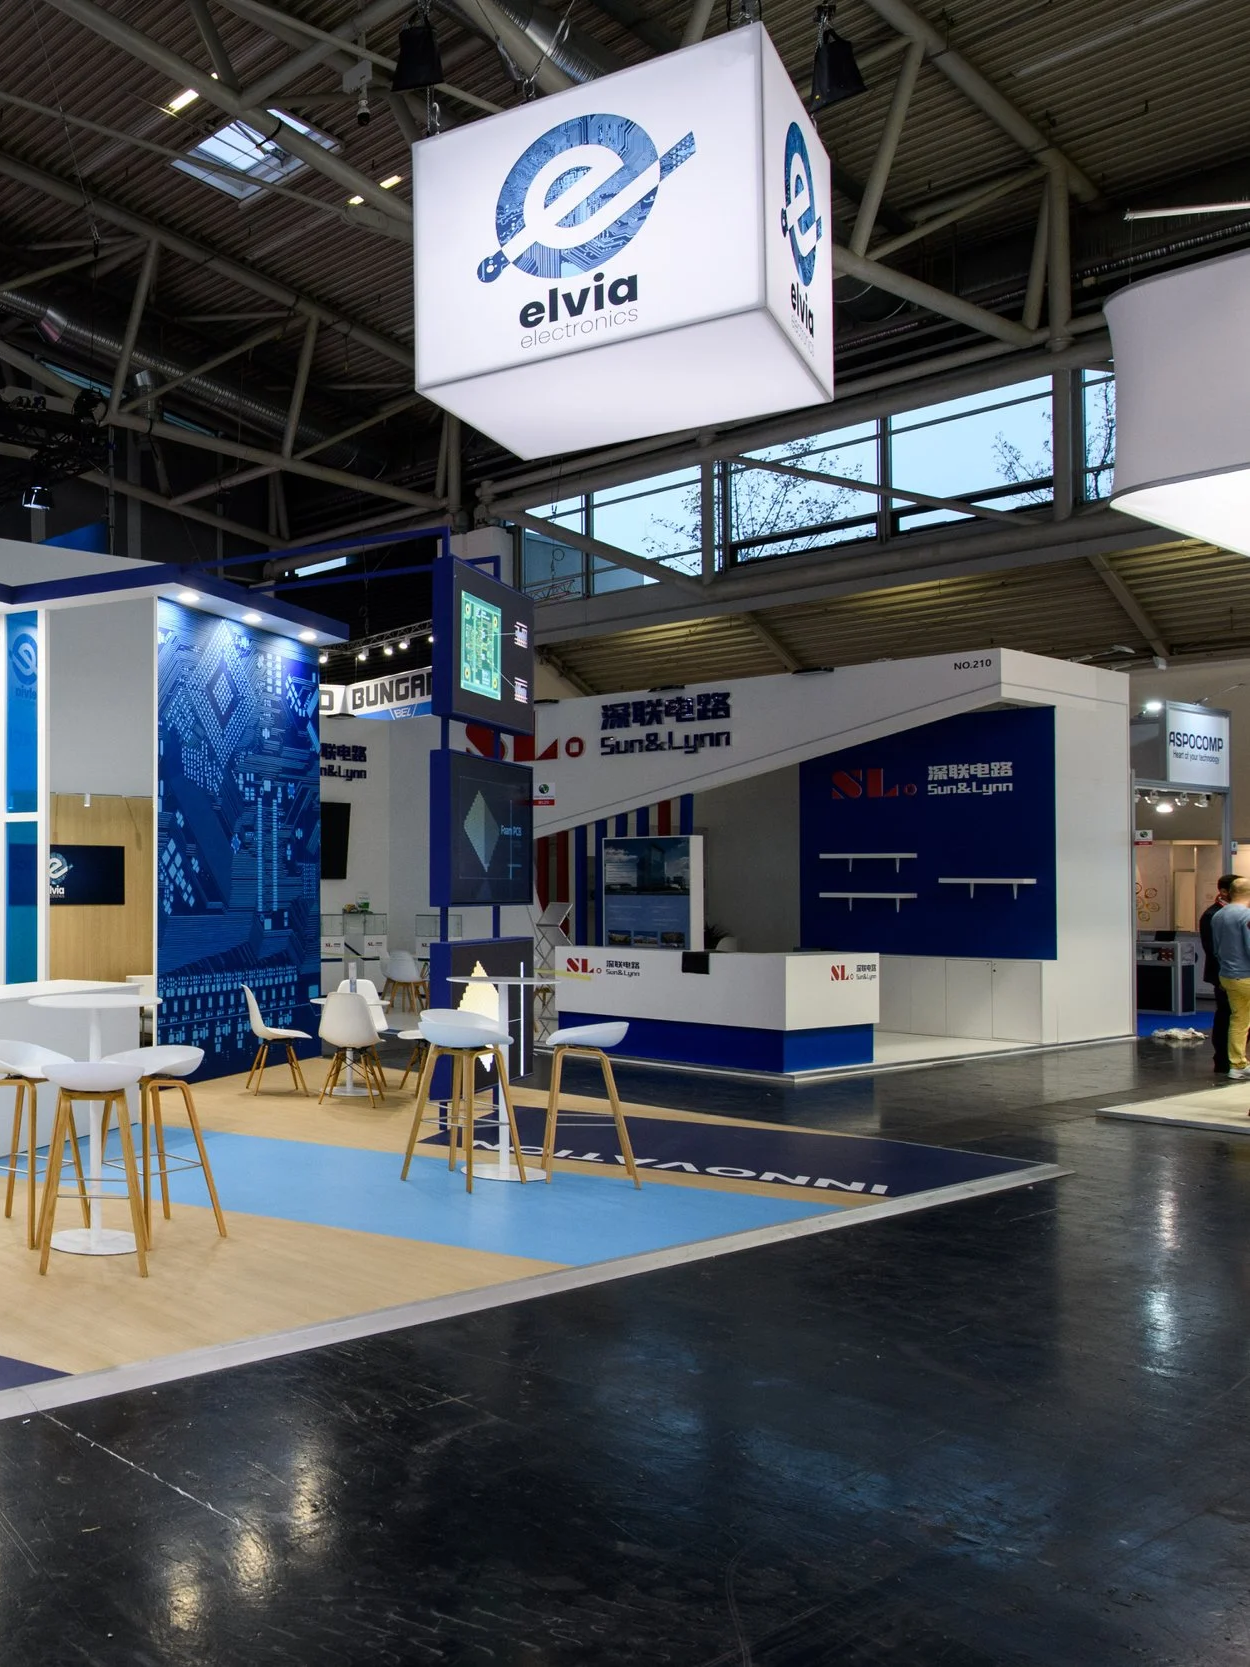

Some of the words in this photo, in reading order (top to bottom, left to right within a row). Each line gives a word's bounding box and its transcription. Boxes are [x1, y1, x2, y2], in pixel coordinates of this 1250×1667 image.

[519, 272, 638, 329] elvia
[791, 282, 814, 338] elvia
[520, 306, 639, 349] electronics
[953, 658, 992, 670] NO.210
[601, 692, 730, 730] 深联电路
[601, 731, 731, 755] Sun&Lynn
[1168, 731, 1223, 752] ASPOCOMP
[928, 762, 1013, 780] 深联电路
[928, 782, 1013, 795] Sun&Lynn
